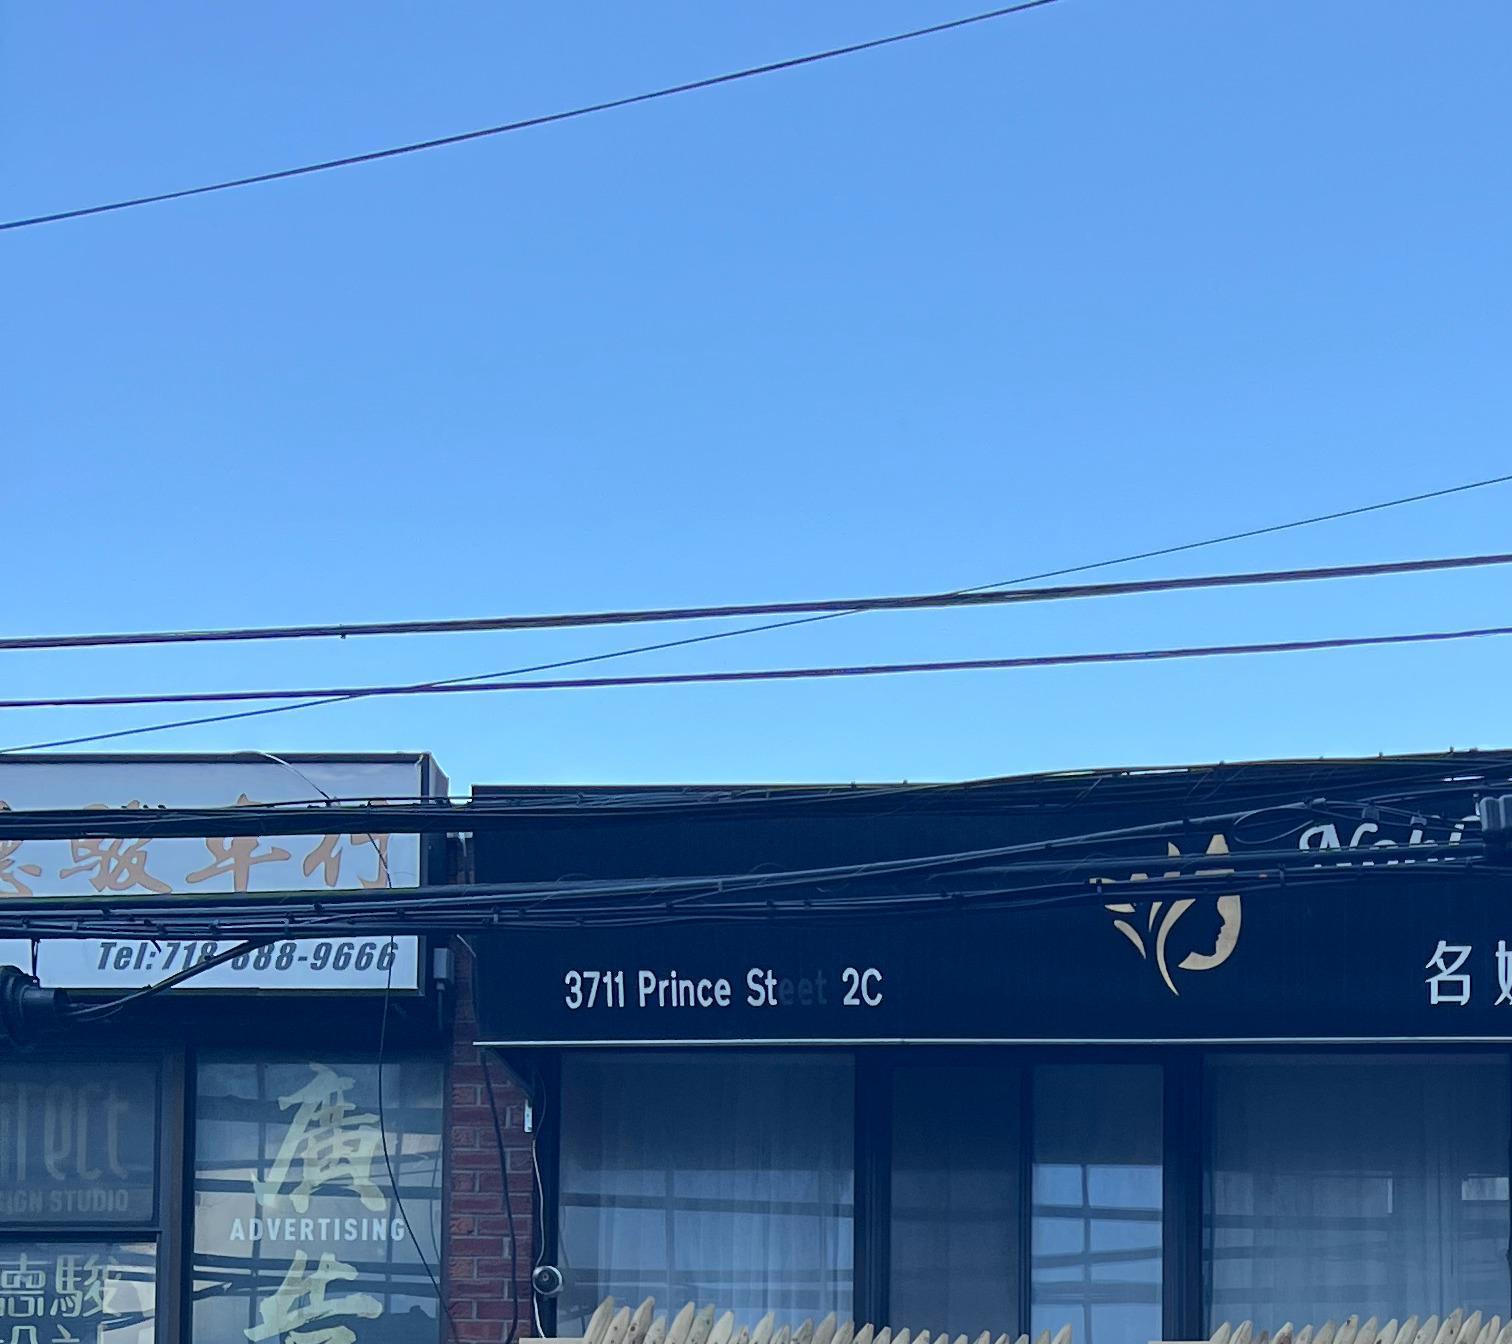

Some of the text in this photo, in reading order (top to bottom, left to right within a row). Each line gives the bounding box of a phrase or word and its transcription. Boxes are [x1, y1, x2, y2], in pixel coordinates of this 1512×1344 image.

[564, 970, 625, 1009] 3711
[638, 969, 732, 1008] Prince
[842, 967, 883, 1007] 2C
[229, 1217, 405, 1241] ADVERTISING
